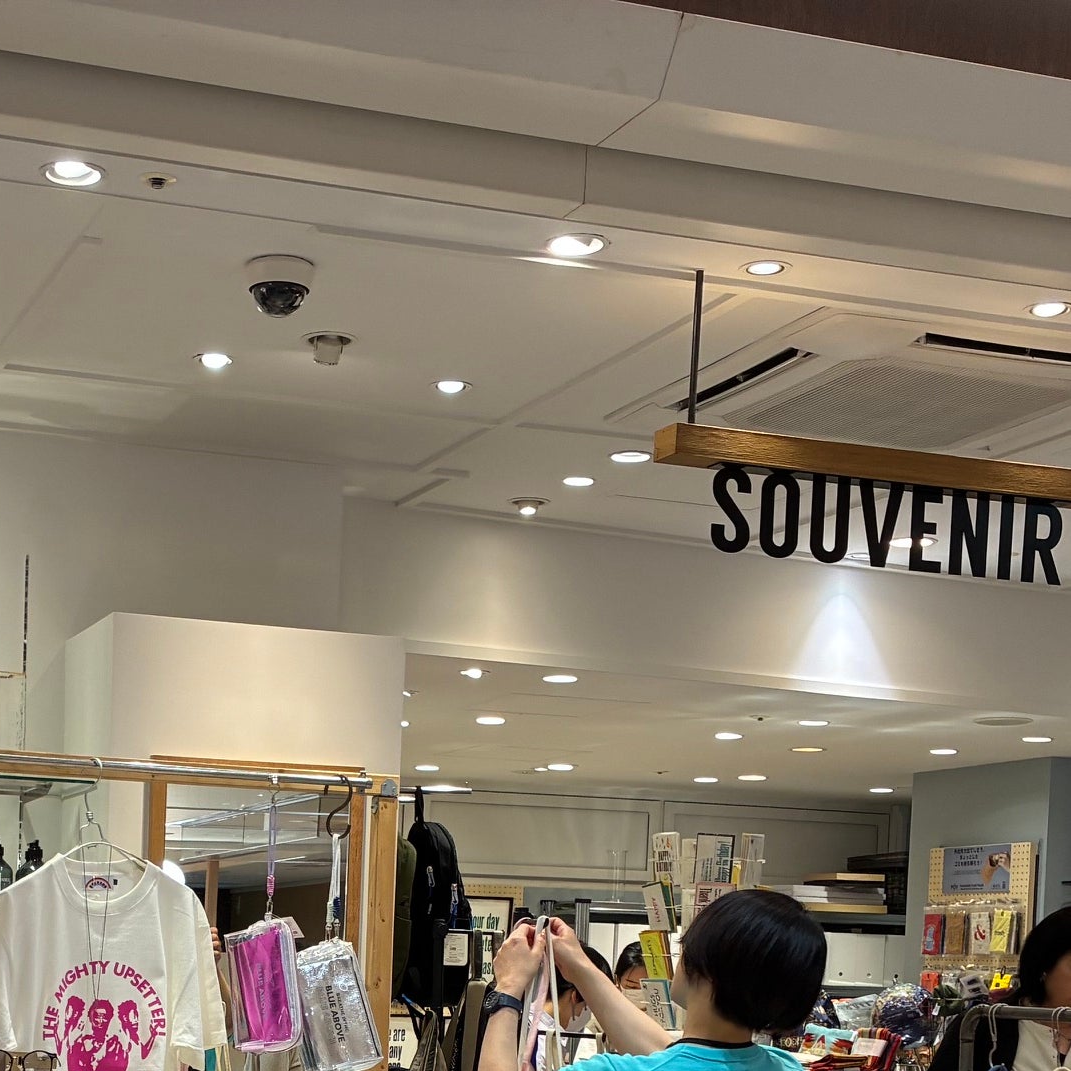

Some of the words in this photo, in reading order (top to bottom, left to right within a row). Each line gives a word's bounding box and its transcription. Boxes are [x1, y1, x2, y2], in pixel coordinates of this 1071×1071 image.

[711, 465, 1063, 585] SOUVENIR
[486, 913, 500, 930] day
[42, 1006, 59, 1041] THE
[54, 960, 110, 1003] MIGHTY
[325, 985, 337, 1011] BLUE
[331, 1010, 346, 1043] ABOVE
[393, 1028, 406, 1041] are
